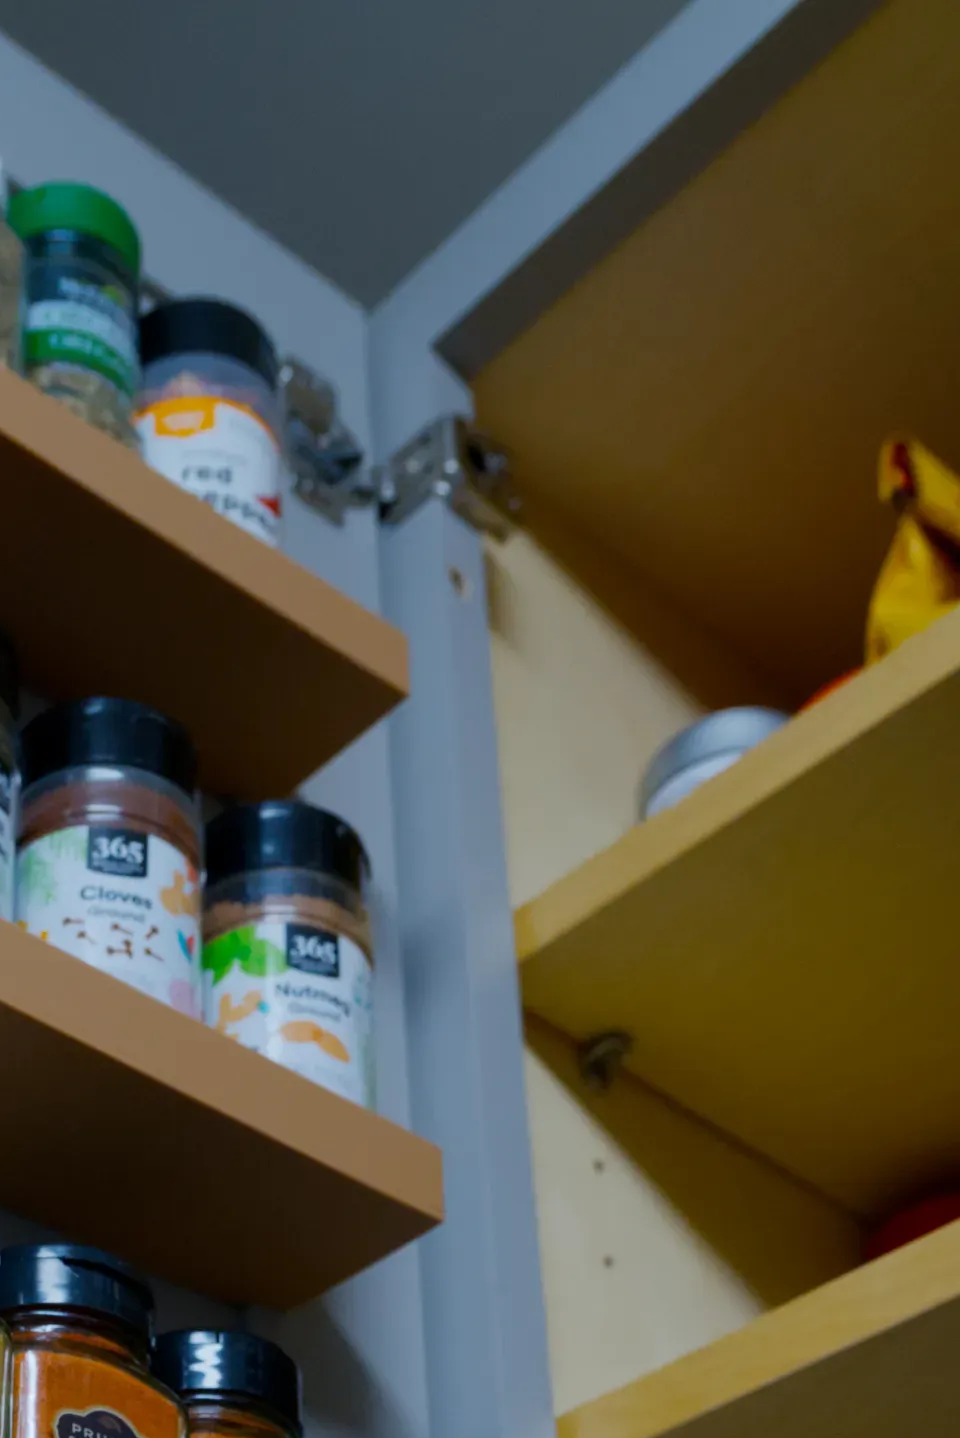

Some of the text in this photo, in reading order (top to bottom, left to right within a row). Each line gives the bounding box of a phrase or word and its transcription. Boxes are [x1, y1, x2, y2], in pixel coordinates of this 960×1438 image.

[92, 836, 144, 864] 365
[80, 885, 153, 910] Cloves
[289, 934, 336, 965] 365
